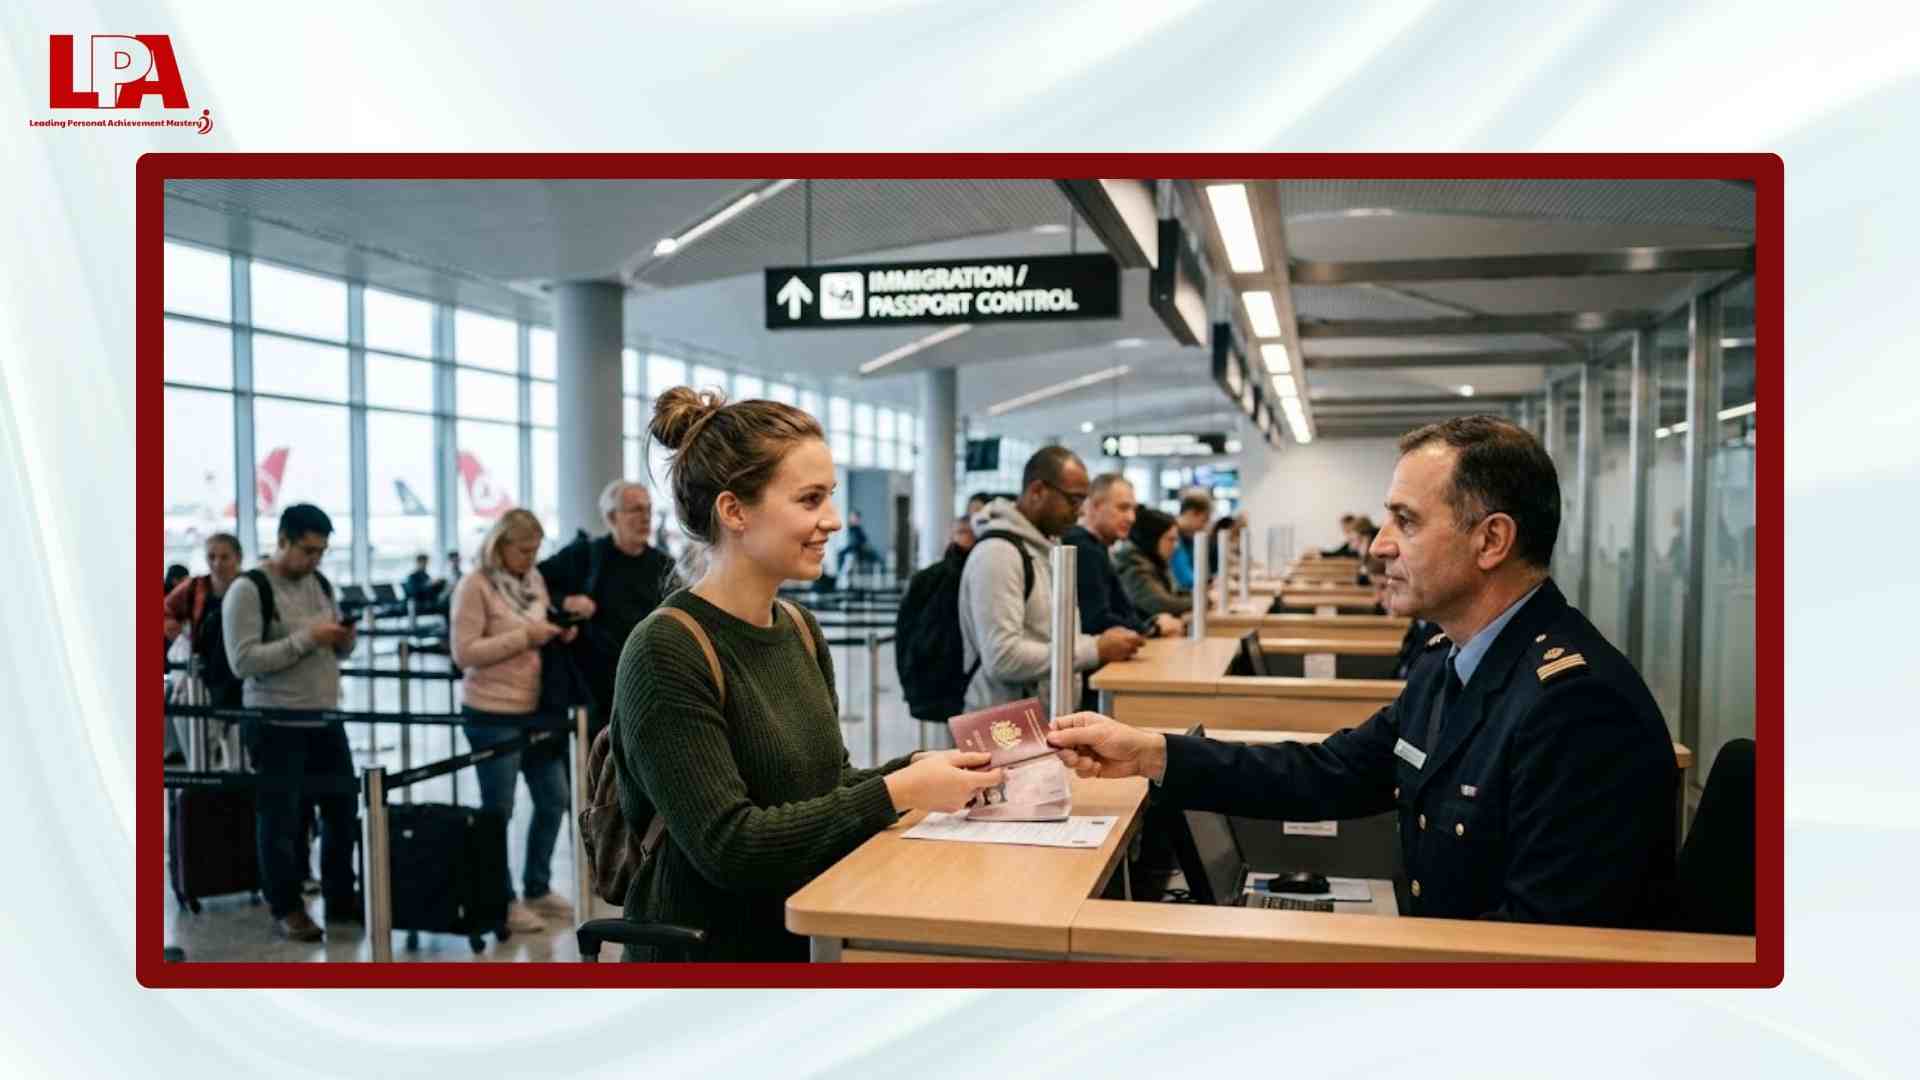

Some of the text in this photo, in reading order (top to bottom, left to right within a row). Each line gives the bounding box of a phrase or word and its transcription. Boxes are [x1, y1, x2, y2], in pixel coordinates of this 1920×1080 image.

[868, 265, 1014, 293] IMMIGRATION
[868, 288, 1080, 317] PASSPORT CONTROL
